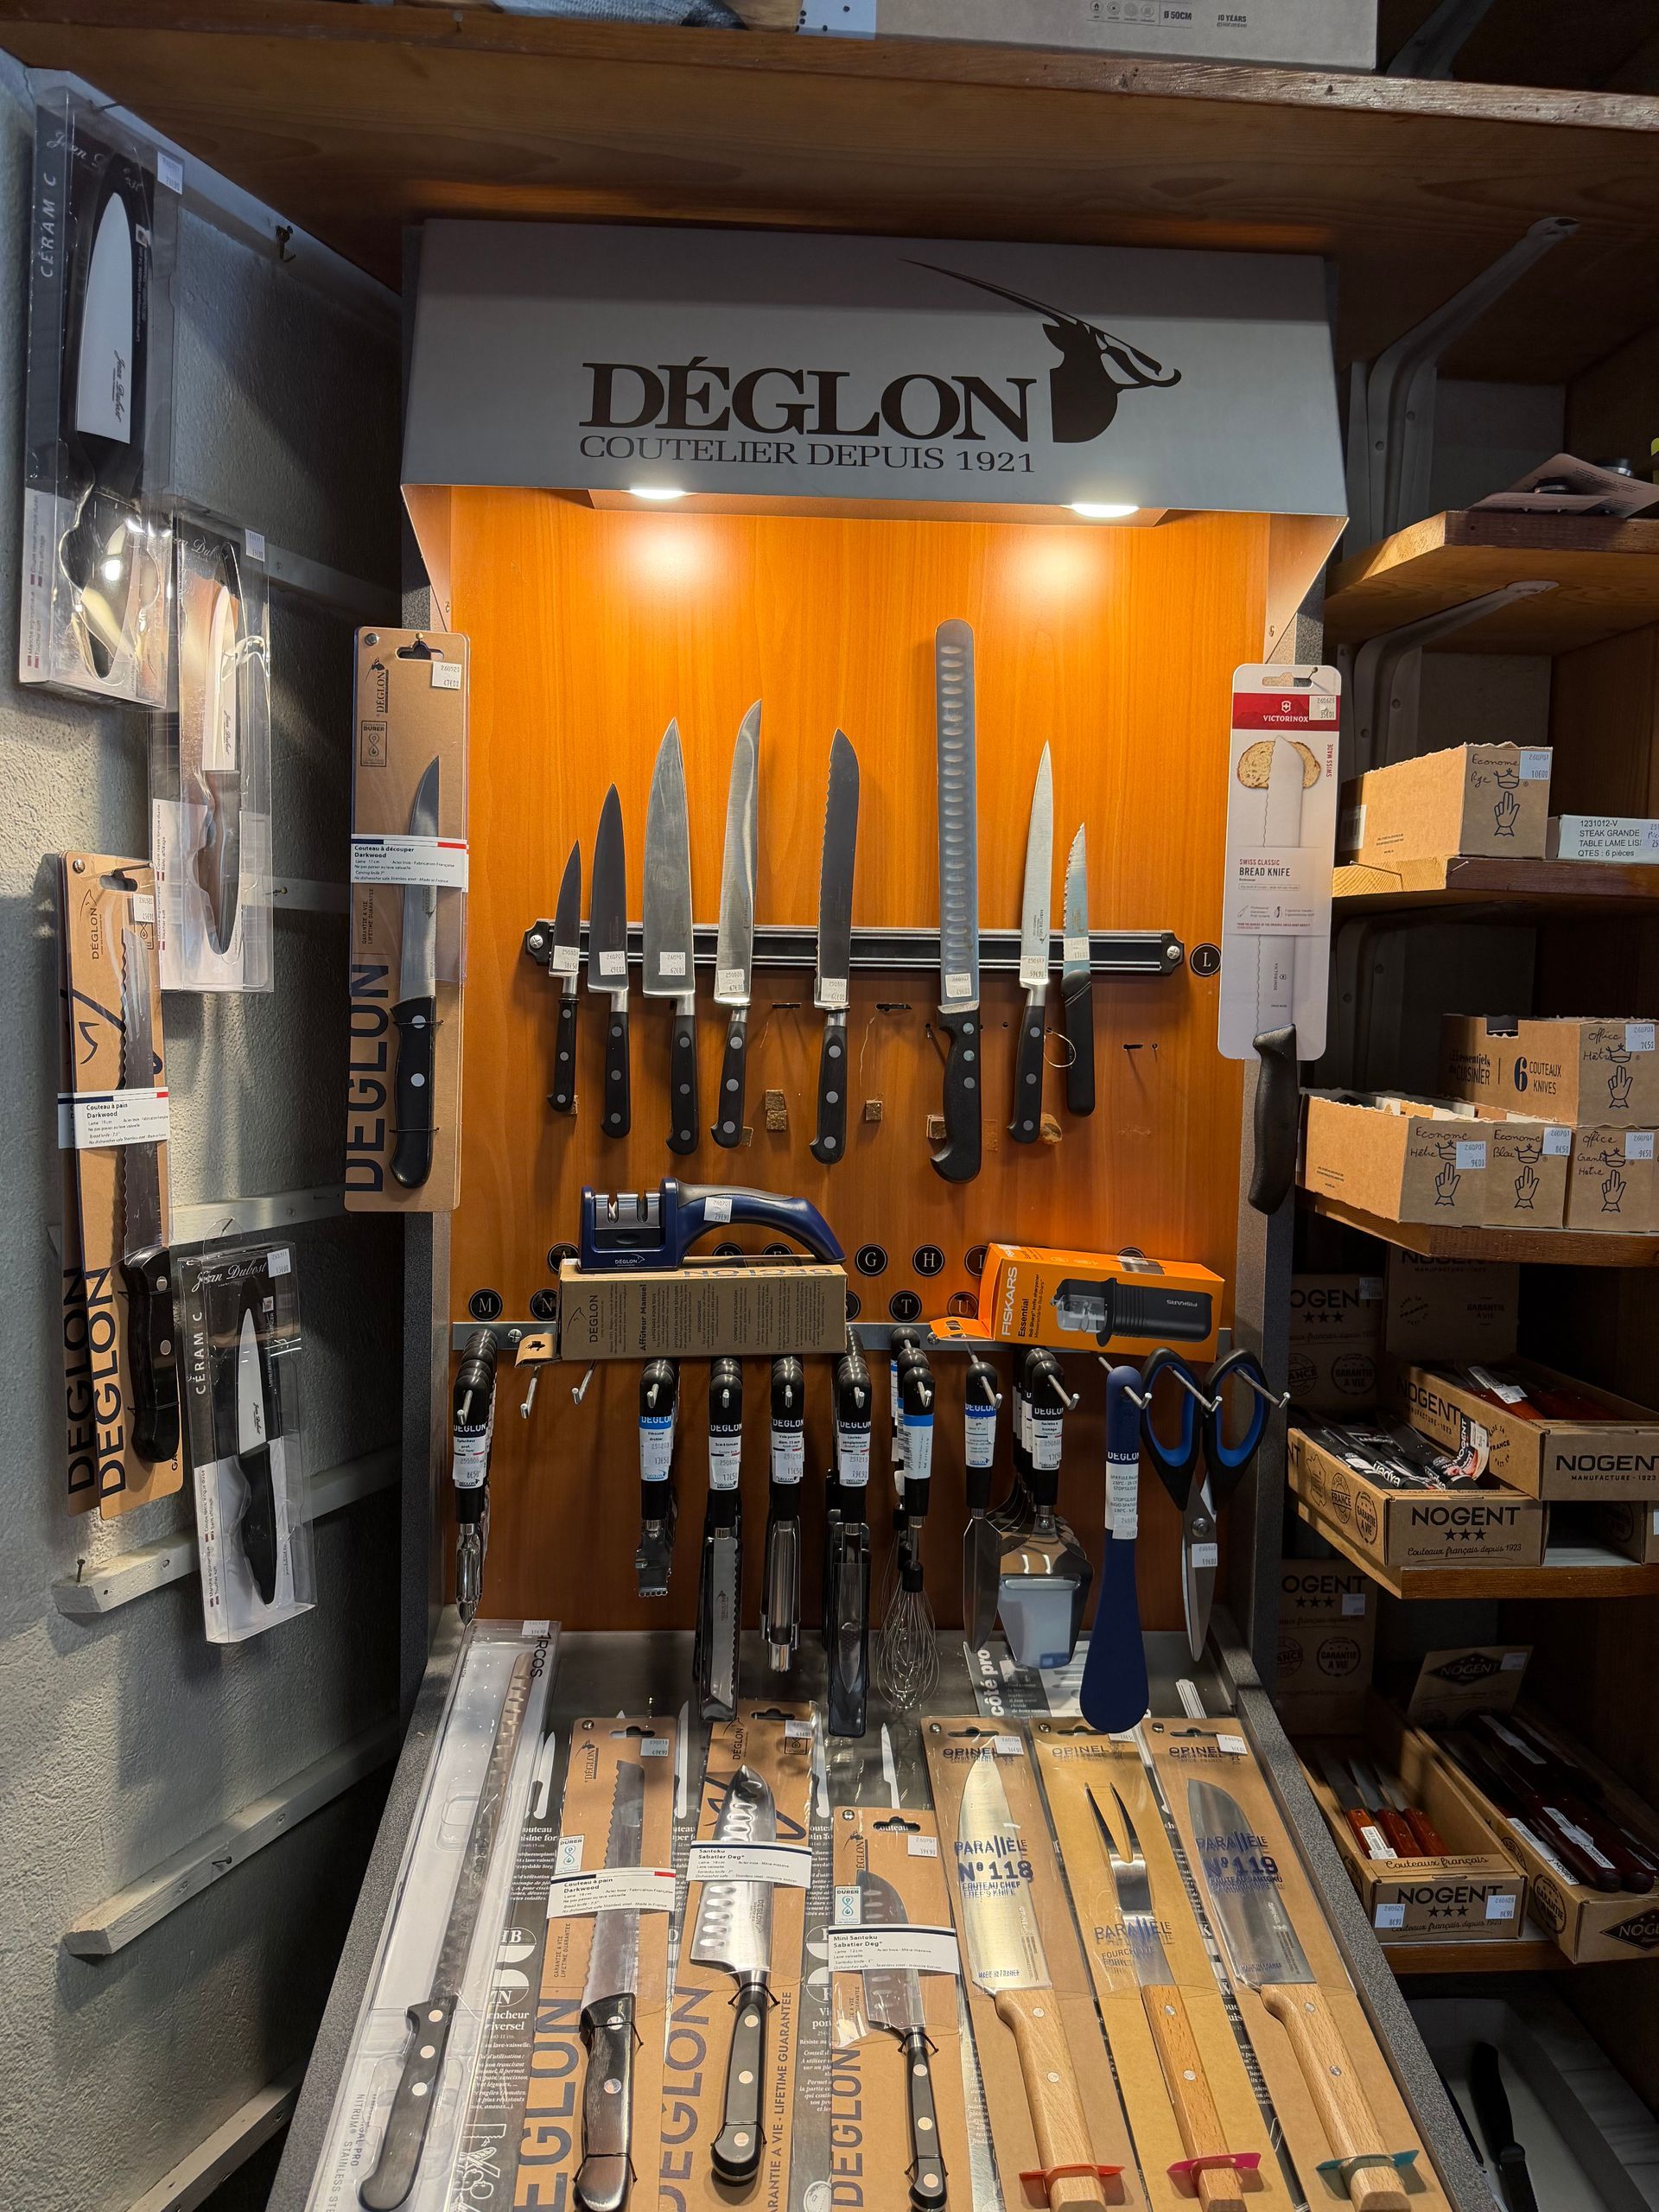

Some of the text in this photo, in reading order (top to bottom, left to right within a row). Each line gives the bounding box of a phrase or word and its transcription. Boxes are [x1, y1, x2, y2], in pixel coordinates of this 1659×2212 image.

[1170, 11, 1192, 20] 50CM
[579, 356, 1036, 442] DÉGLON
[579, 435, 1036, 474] COUTELIER DEPUIS 1921
[376, 671, 385, 713] DÉGLON
[1611, 849, 1635, 858] pièces
[1239, 868, 1290, 876] BREAD KNIFE
[92, 907, 100, 960] DÉGLON
[1202, 952, 1211, 967] L
[346, 963, 389, 1192] DEGLON
[1514, 1056, 1562, 1092] 6 COUTEAUX
[1533, 1080, 1556, 1095] KNIVES
[226, 1259, 268, 1280] Dubost
[865, 1252, 877, 1267] G
[922, 1253, 936, 1268] H
[479, 1298, 493, 1313] M
[541, 1298, 554, 1313] N
[901, 1300, 912, 1314] T
[958, 1300, 969, 1314] U
[1001, 1267, 1018, 1336] FISKARS
[1166, 1299, 1198, 1307] FISKARS
[1291, 1288, 1371, 1308] OGENT
[589, 1295, 599, 1343] DÉGLON
[1018, 1299, 1029, 1338] Essential
[639, 1317, 647, 1351] Affûteur
[63, 1266, 95, 1496] DEGLON
[86, 1266, 127, 1498] DEGLON
[1396, 1375, 1461, 1426] NOGENT
[452, 1423, 486, 1433] DEGLON
[772, 1419, 804, 1427] DEGLON
[1452, 1418, 1467, 1465] NOGENT
[1490, 1440, 1510, 1452] FRANCE
[1107, 1452, 1140, 1461] DEGLON
[1332, 1491, 1351, 1507] FRANCE
[1357, 1503, 1376, 1527] GARANTIE
[1411, 1506, 1521, 1526] NOGENT
[1408, 1543, 1522, 1558] Couteaux français depuis 1923
[1282, 1575, 1367, 1594] OGENT
[1321, 1651, 1357, 1661] GARANTIE
[977, 1649, 1005, 1717] côté pro
[732, 1727, 745, 1760] DÉGLON
[1052, 1745, 1109, 1756] OPINEL
[584, 1747, 594, 1781] DÉGLON
[855, 1840, 865, 1869] ÉGLON
[1385, 1856, 1490, 1870] Couteaux français
[1554, 1860, 1579, 1884] NOGENT
[1397, 1885, 1503, 1904] NOGENT
[1427, 1921, 1460, 1932] français
[772, 1992, 792, 2115] LIFETIME GUARANTEE
[513, 1998, 583, 2208] EGLON
[771, 2124, 784, 2144] VIE
[831, 2048, 863, 2208] DEGLON
[332, 2141, 353, 2192] STAINLESS
[349, 2147, 363, 2167] PRO
[767, 2160, 782, 2212] ARANTIE
